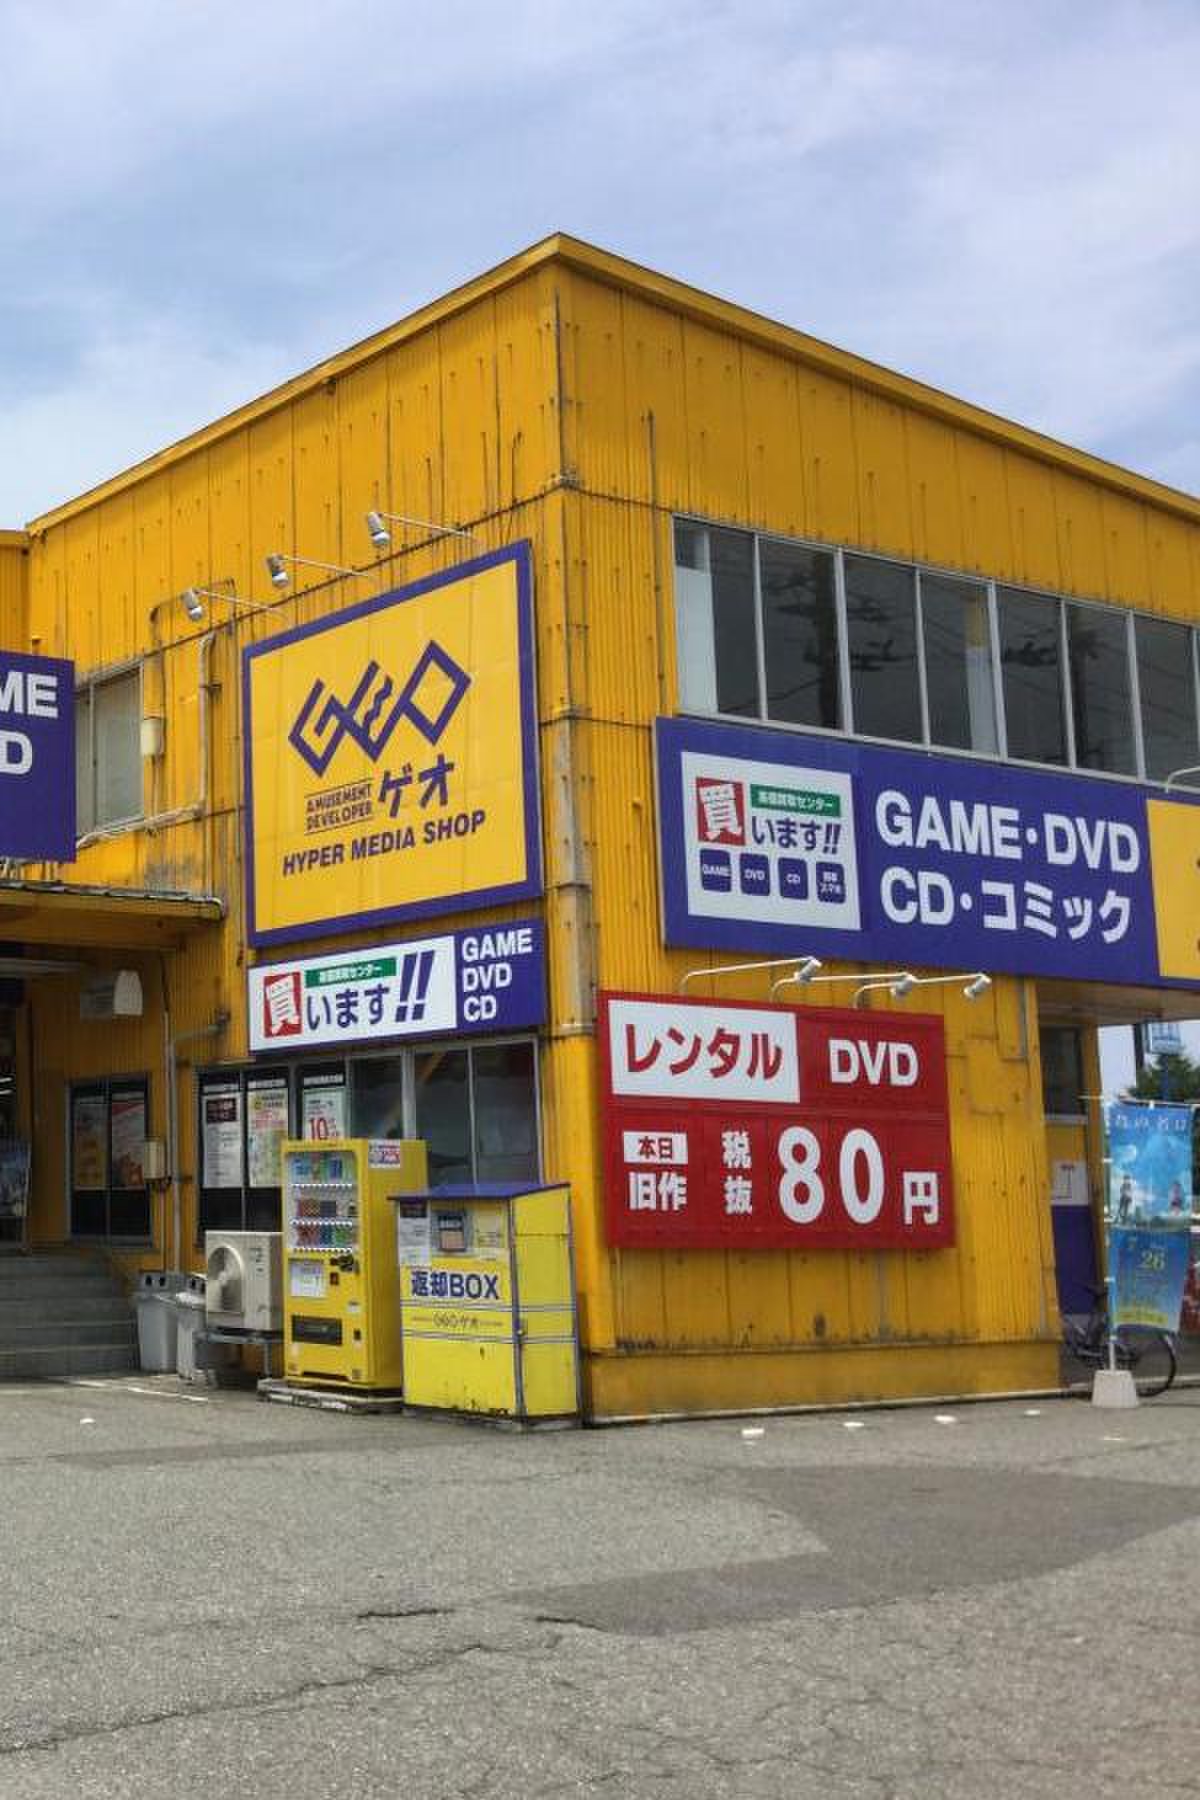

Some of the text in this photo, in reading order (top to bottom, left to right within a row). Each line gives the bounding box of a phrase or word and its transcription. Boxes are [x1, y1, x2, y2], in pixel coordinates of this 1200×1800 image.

[305, 781, 372, 813] AMUSEMENT
[378, 754, 455, 818] ゲオ
[305, 802, 373, 831] DEVELOPER
[282, 809, 487, 877] HYPER MEDIA SHOP
[702, 862, 801, 884] GAME DVD CD
[461, 928, 532, 961] GAME
[462, 962, 513, 992] DVD
[463, 996, 498, 1022] CD
[625, 1023, 919, 1087] レンタル DVD
[637, 1136, 675, 1160] 本日
[628, 1171, 688, 1213] 旧作
[411, 1270, 499, 1300] 返却BOX
